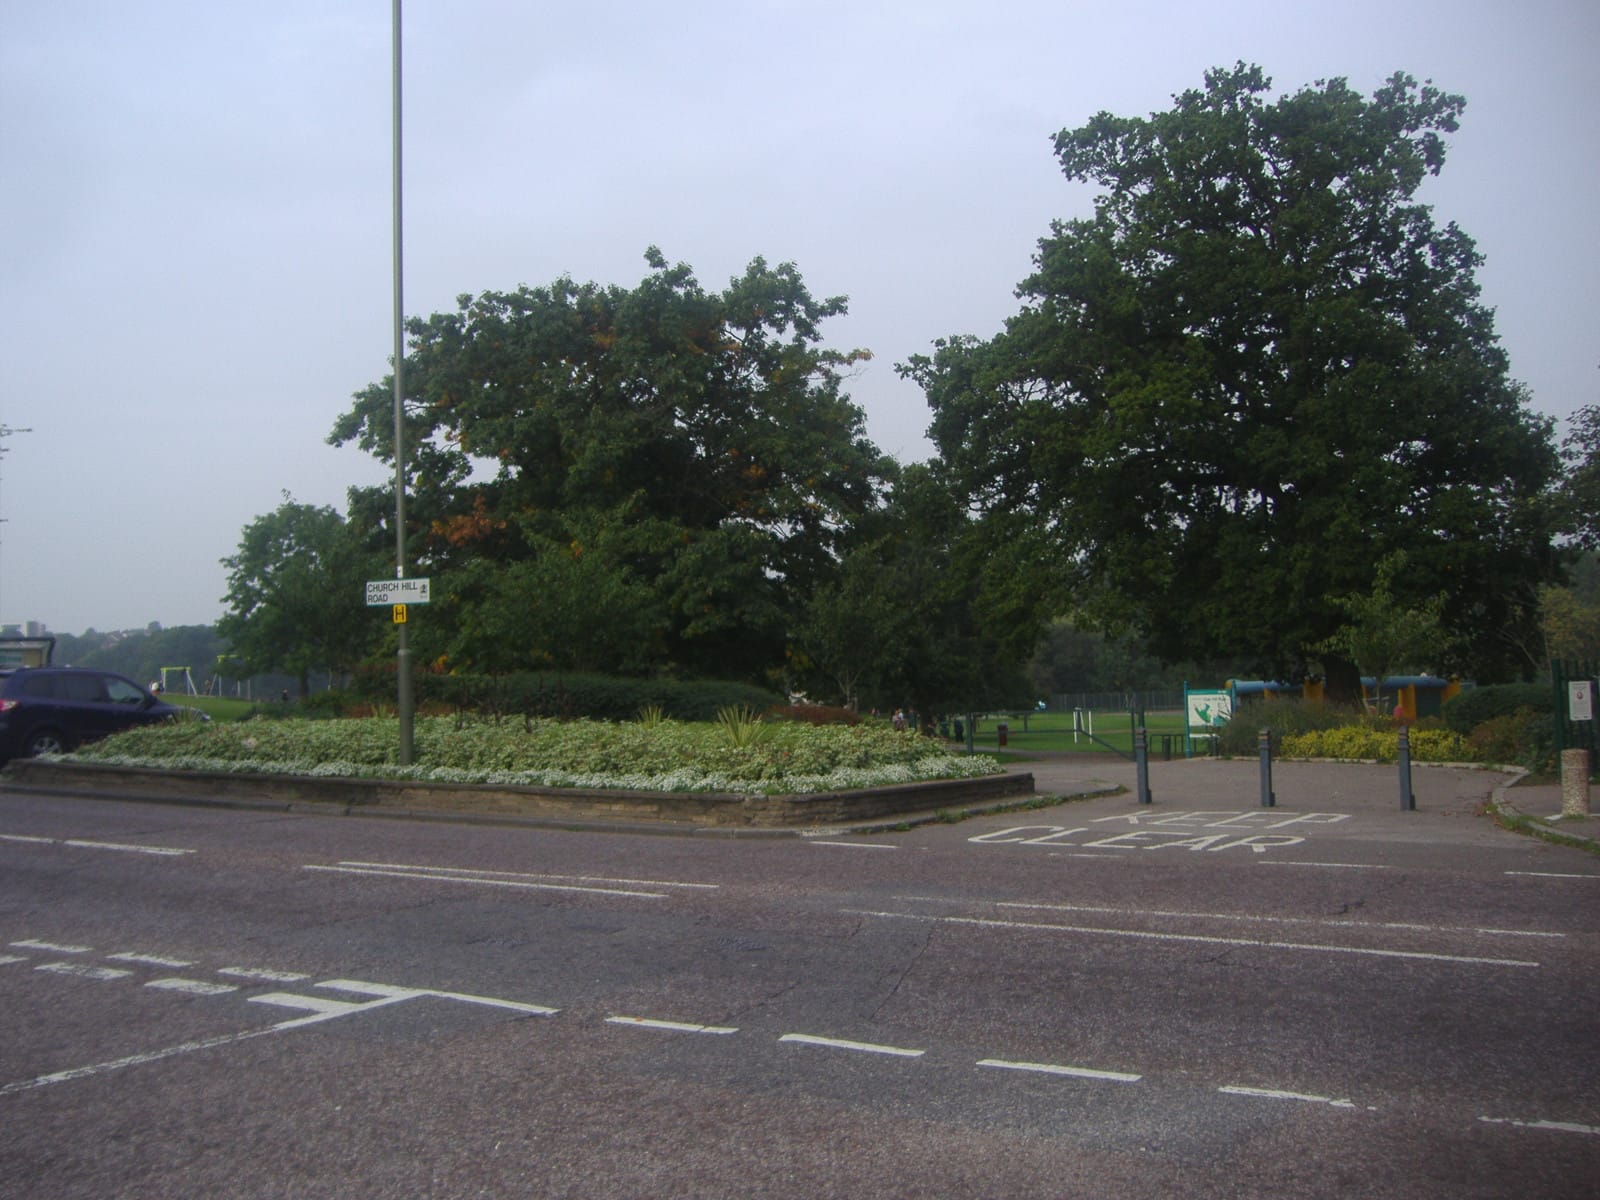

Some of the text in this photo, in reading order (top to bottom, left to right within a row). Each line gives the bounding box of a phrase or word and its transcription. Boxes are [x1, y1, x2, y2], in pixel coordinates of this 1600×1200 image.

[367, 581, 418, 593] CHURCH HILL
[368, 594, 388, 603] ROAD
[395, 606, 404, 621] H
[1089, 810, 1352, 829] KEEP
[967, 825, 1306, 853] CLEAR
